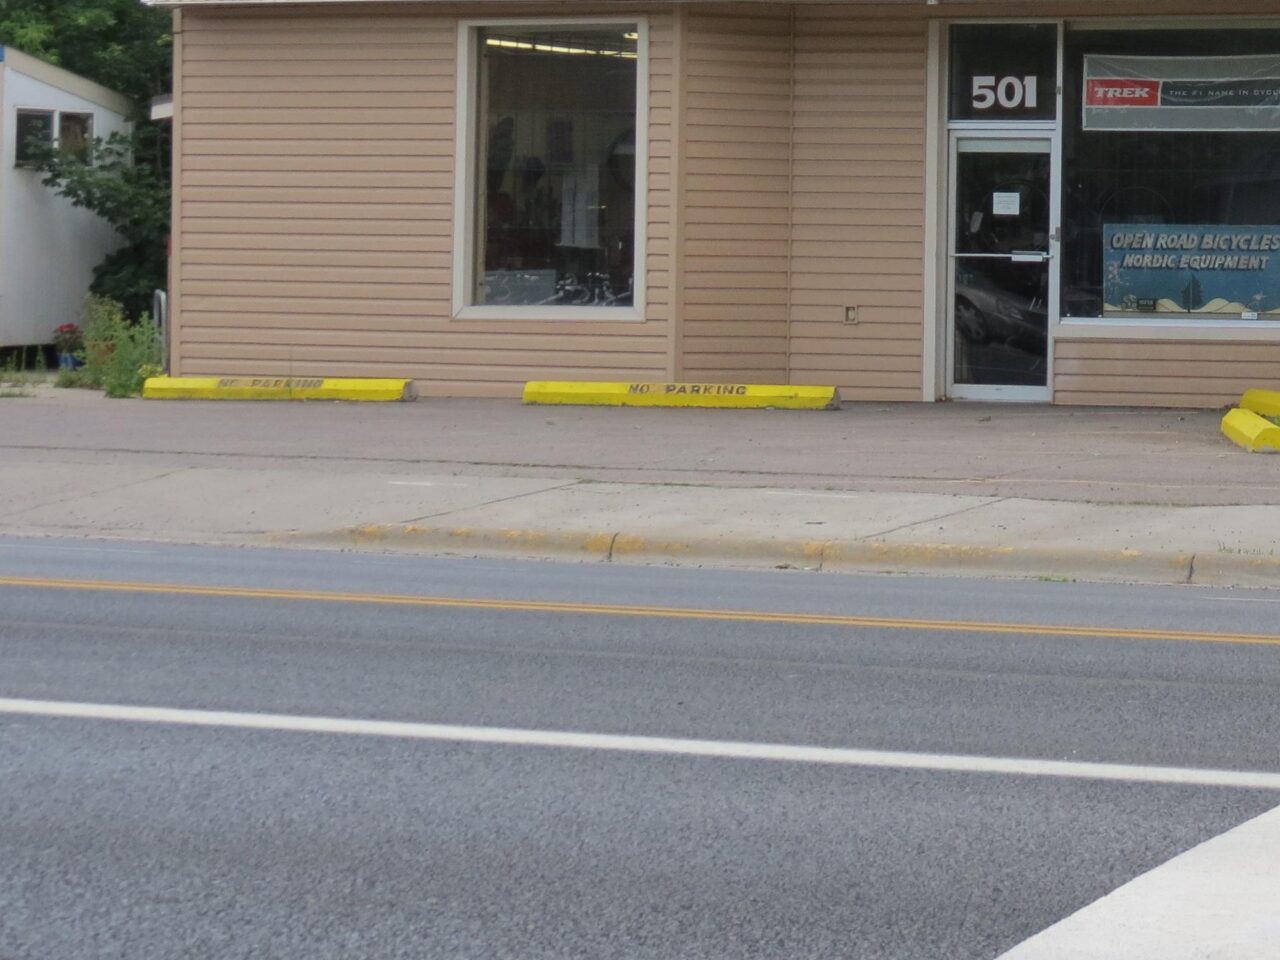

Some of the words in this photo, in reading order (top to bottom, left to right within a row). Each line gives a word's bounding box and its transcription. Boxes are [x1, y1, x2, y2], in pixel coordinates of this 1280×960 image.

[971, 75, 1038, 109] 501
[1095, 87, 1150, 98] TREK
[1112, 232, 1154, 250] OPEN
[1156, 233, 1199, 250] ROAD
[1201, 234, 1280, 251] BICYCLES
[1122, 253, 1176, 268] NORDIC
[1179, 254, 1270, 270] EQUIPMENT
[628, 383, 649, 393] NO
[665, 384, 747, 395] PARKING
